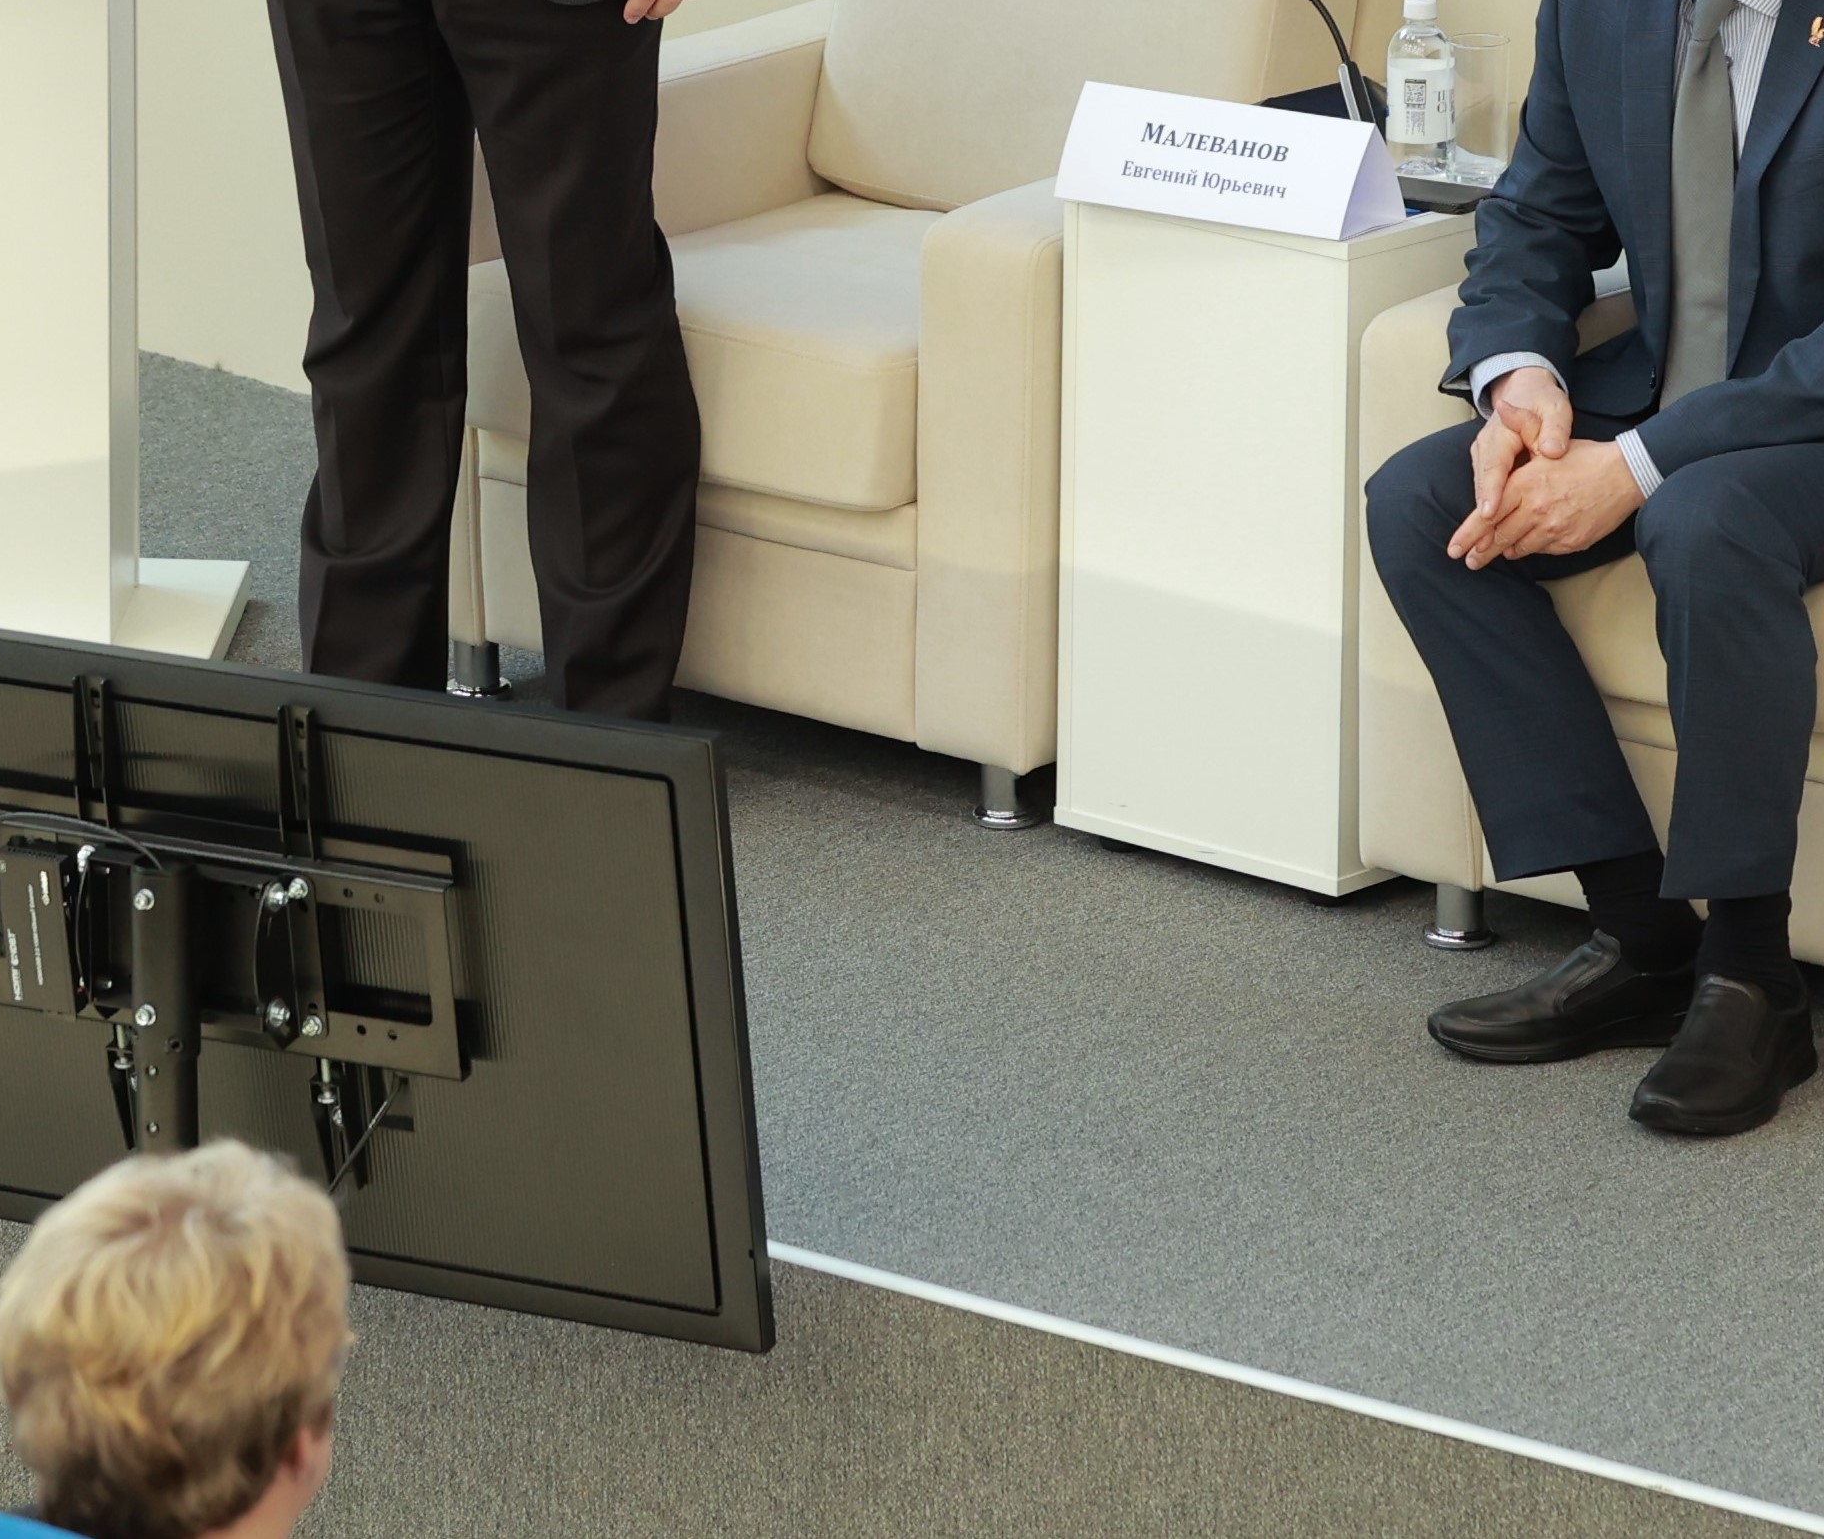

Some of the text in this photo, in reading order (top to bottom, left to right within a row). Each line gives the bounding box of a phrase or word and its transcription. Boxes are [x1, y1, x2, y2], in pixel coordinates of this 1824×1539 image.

[1139, 121, 1290, 163] МАЛЕВАНОВ
[1120, 160, 1287, 199] Евгений Юрьевич
